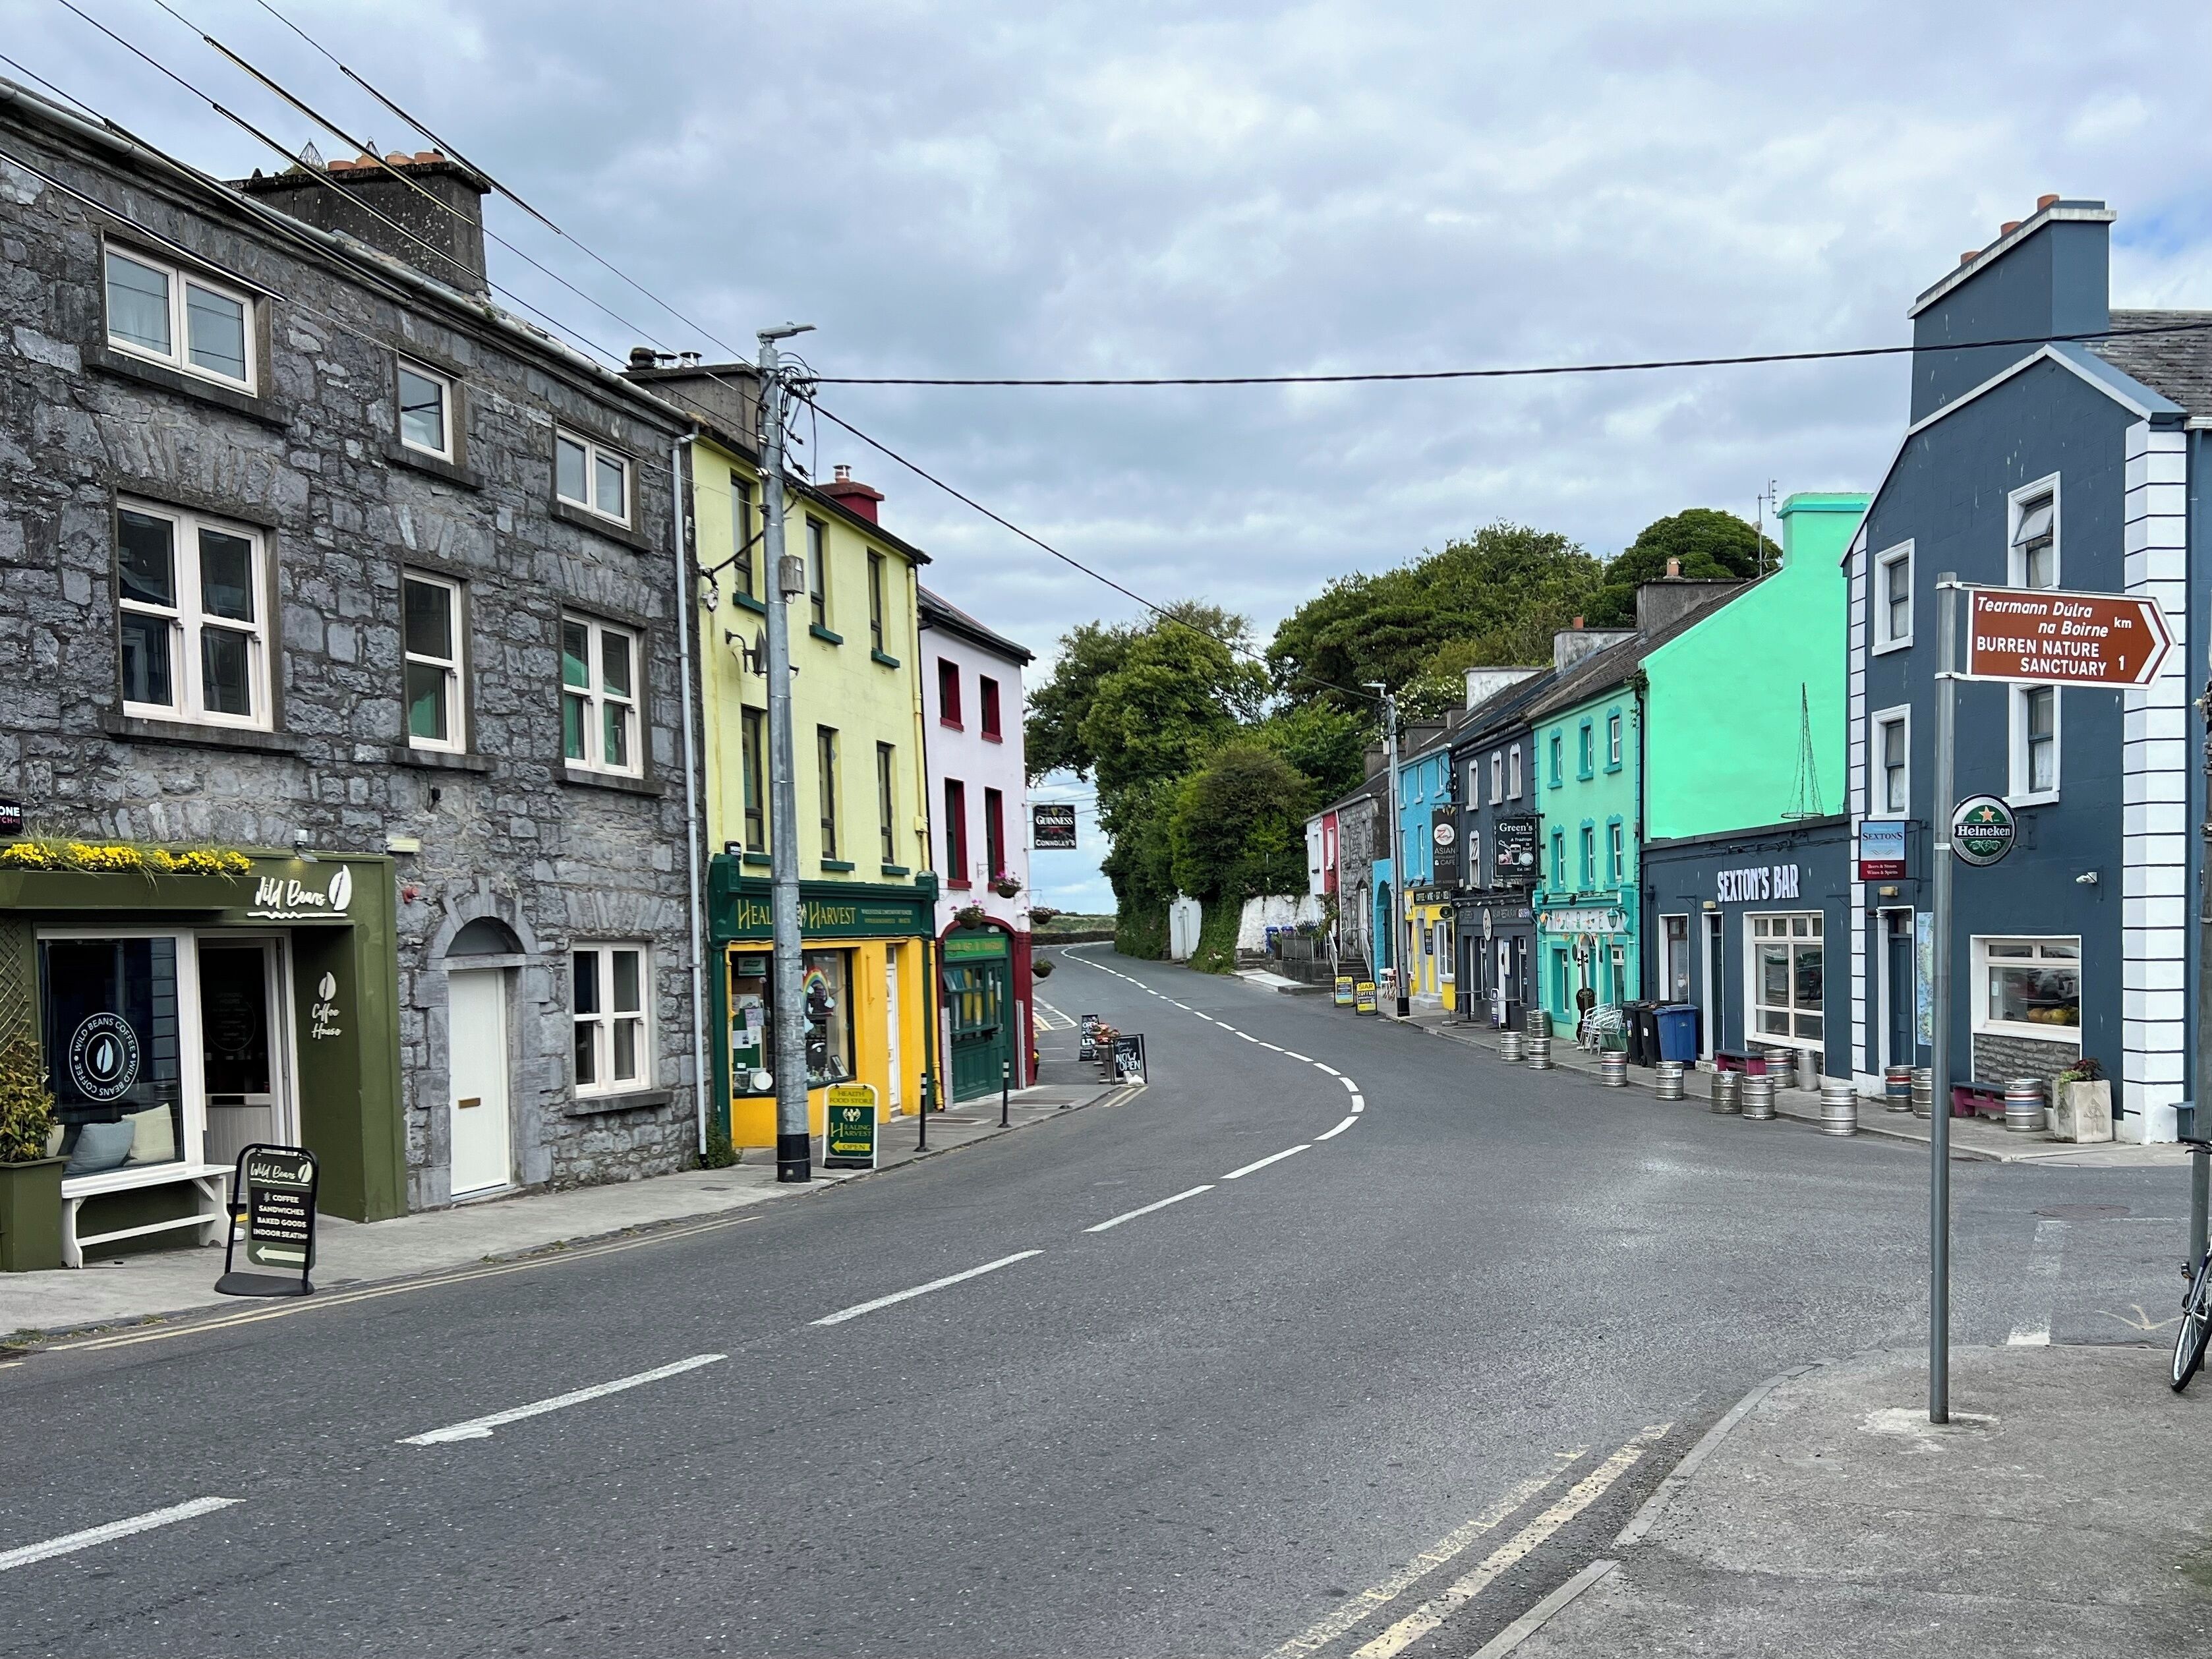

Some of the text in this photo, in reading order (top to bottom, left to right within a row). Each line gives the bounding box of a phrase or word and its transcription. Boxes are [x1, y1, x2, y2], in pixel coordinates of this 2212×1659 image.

[1978, 597, 2092, 618] Tearmann Dúlra
[2038, 620, 2109, 637] na Boirne
[2114, 616, 2132, 629] km
[1977, 636, 2099, 658] BURREN NATURE
[2020, 656, 2107, 676] SANCTUARY
[2118, 655, 2125, 671] 1
[0, 805, 20, 817] ONE
[1035, 815, 1074, 825] GUINNESS
[1499, 822, 1533, 832] Green's
[1957, 825, 2010, 836] Heineken
[1717, 864, 1799, 902] SEXTON'S BAR
[286, 879, 327, 907] Beans
[737, 899, 856, 929] HEAL HARVEST
[312, 1003, 341, 1024] Coffee
[74, 1017, 136, 1052] WILD BEANS COFFEE
[1115, 1052, 1137, 1063] NOW
[1119, 1060, 1141, 1071] OPEN
[74, 1060, 136, 1096] WILD BEANS COFFEE
[250, 1163, 296, 1180] Wild Beans
[272, 1194, 300, 1204] COFFEE
[258, 1205, 305, 1216] SANDWICHES
[256, 1217, 307, 1228] BAKED GOODS
[253, 1228, 308, 1240] INDOOR SEATIN
